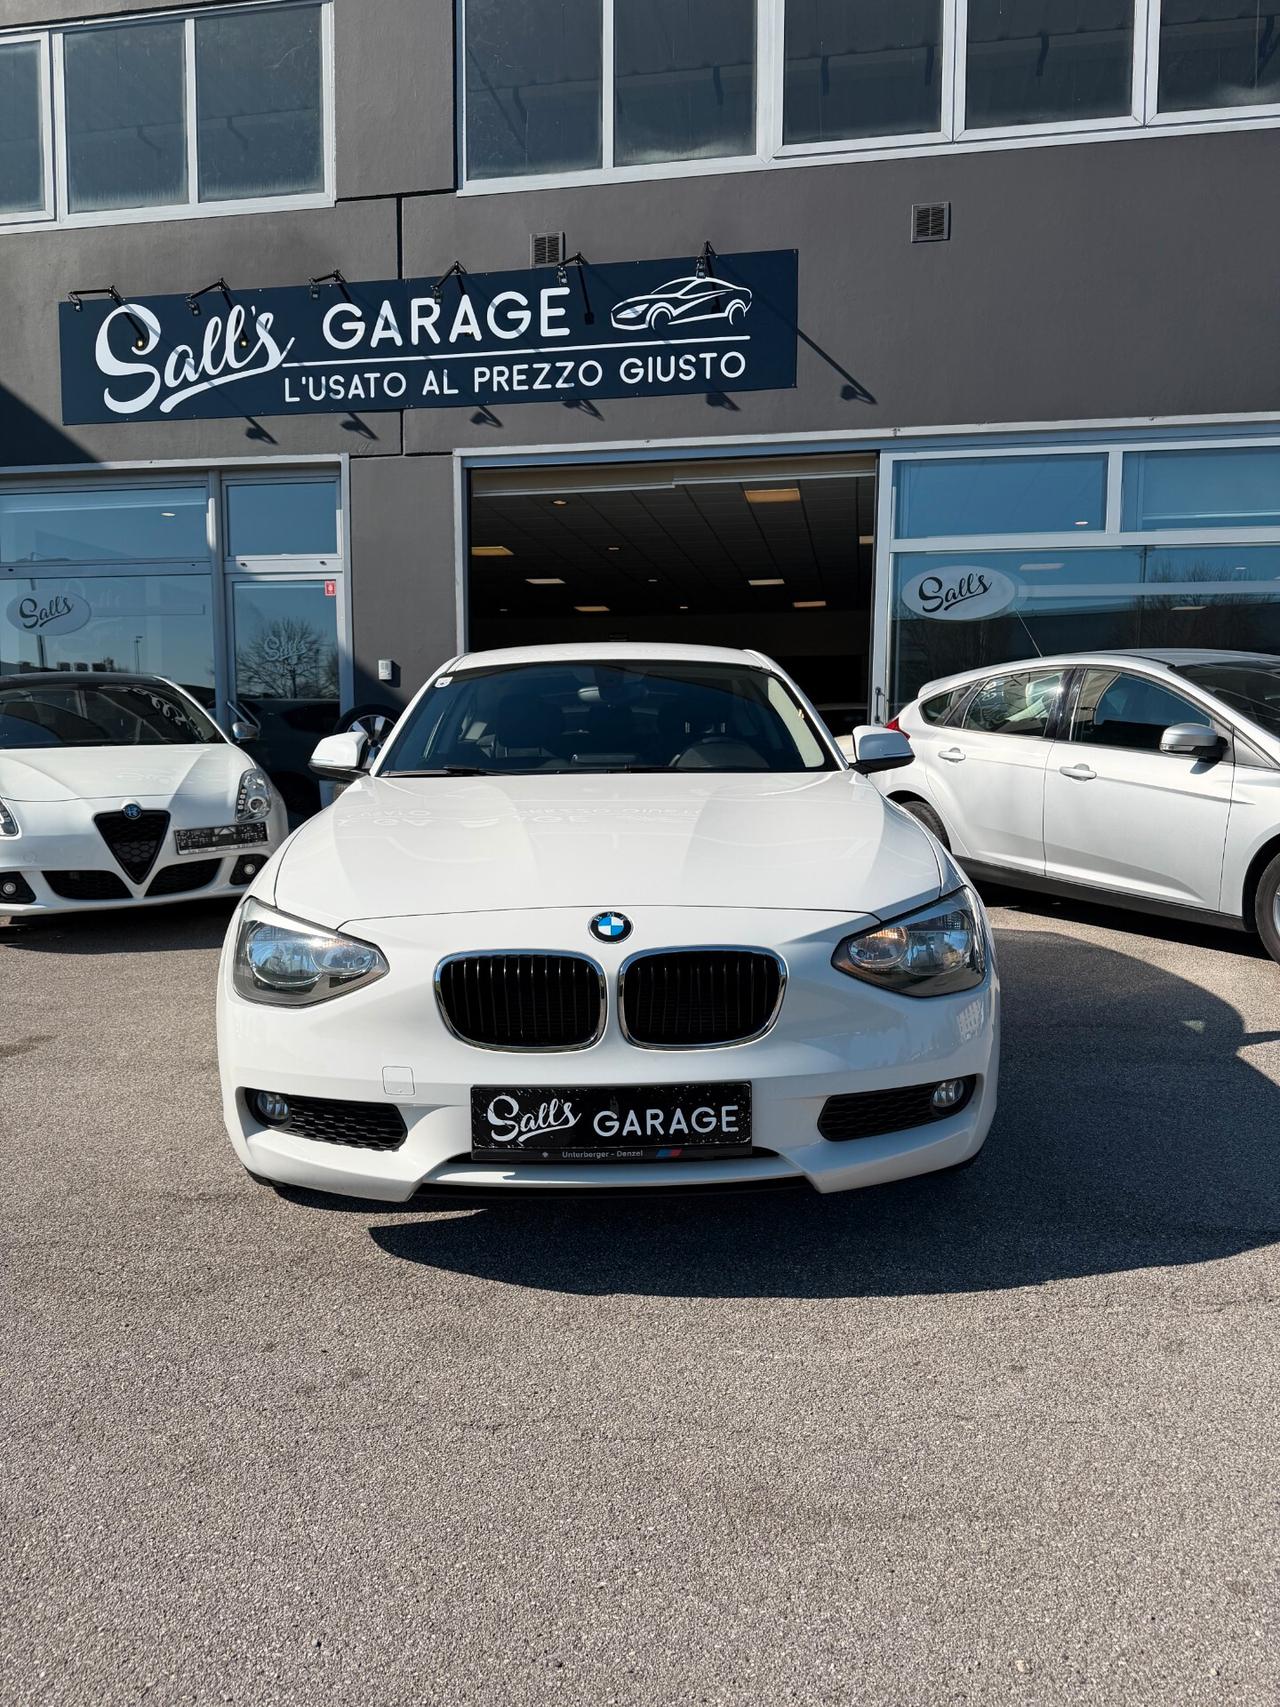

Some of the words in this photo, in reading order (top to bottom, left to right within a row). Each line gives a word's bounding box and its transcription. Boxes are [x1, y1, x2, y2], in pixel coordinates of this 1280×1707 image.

[95, 303, 295, 413] Sall's
[322, 286, 571, 350] GARAGE
[284, 372, 406, 403] L'USATO
[422, 370, 459, 396] AL
[474, 360, 603, 393] PREZZO
[619, 351, 746, 384] GIUSTO
[19, 595, 74, 629] Sall's
[918, 572, 993, 613] Sall's
[487, 1095, 583, 1146] Sall's
[593, 1105, 739, 1137] GARAGE
[562, 1151, 609, 1160] Unterberger
[616, 1149, 643, 1158] Denzel
